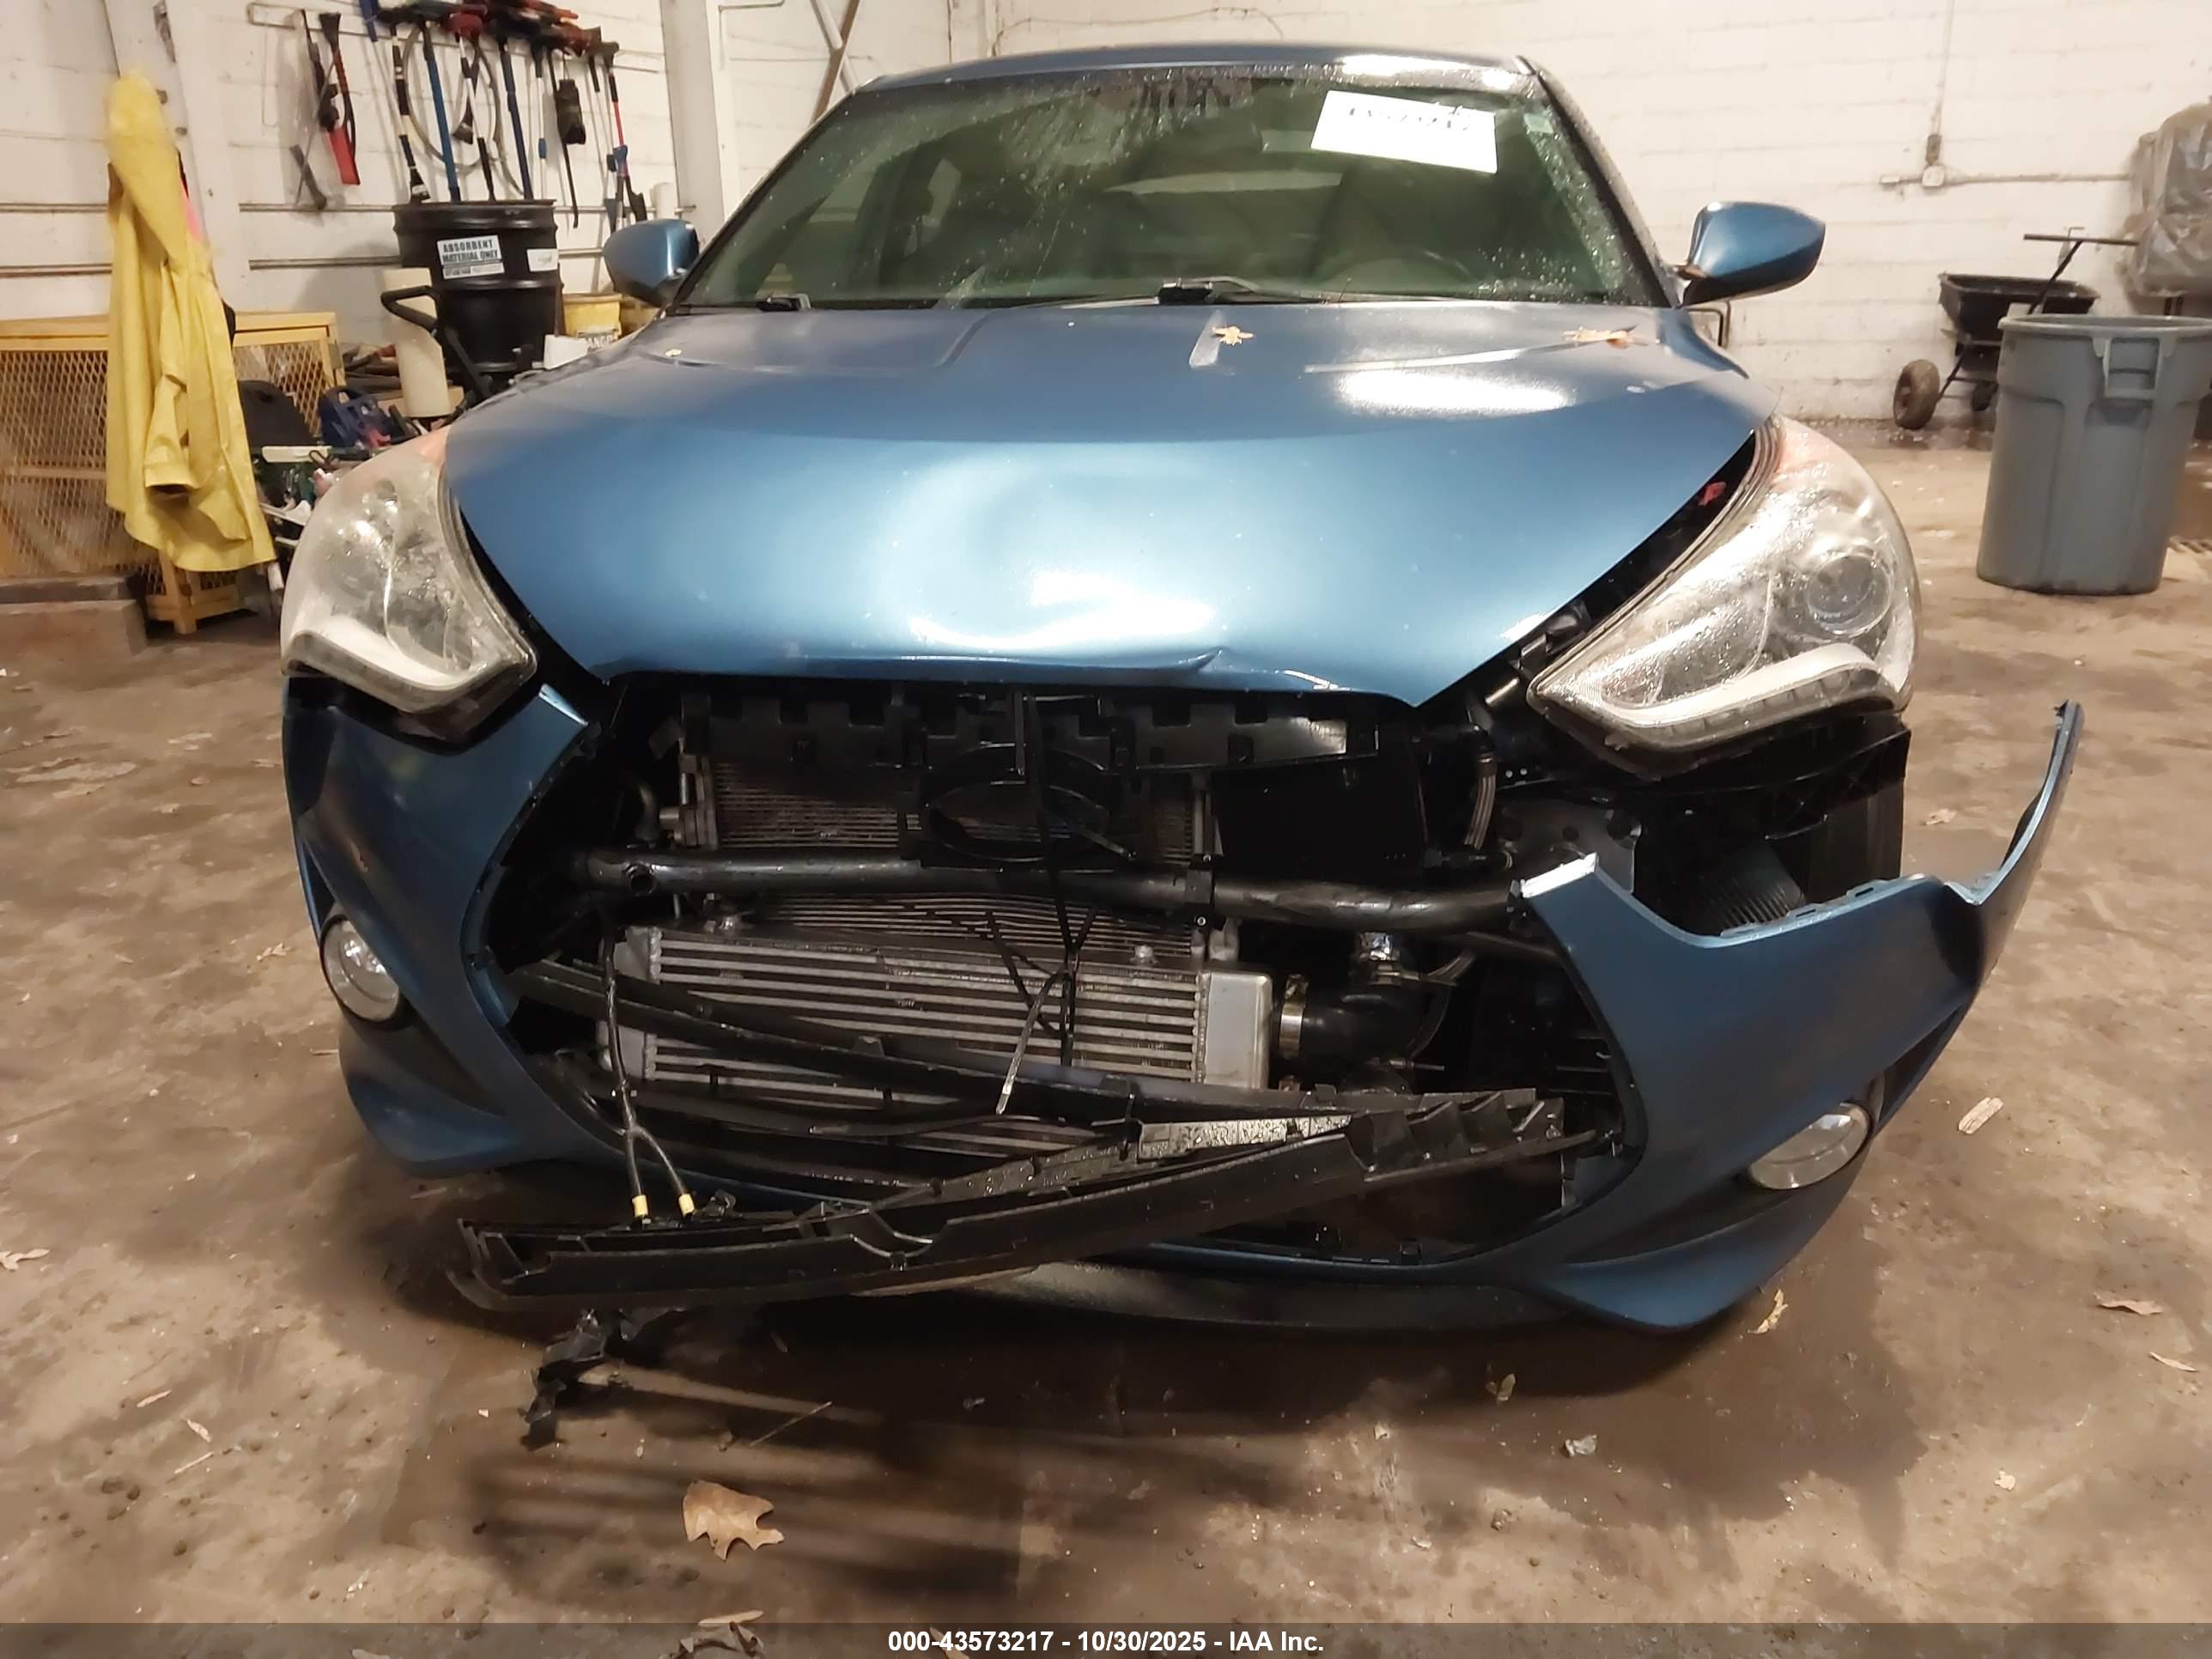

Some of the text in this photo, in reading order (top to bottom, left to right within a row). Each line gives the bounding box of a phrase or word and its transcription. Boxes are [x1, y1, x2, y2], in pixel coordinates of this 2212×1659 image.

[442, 240, 494, 252] ABSORBENT
[442, 249, 498, 263] MATERIAL ONLY
